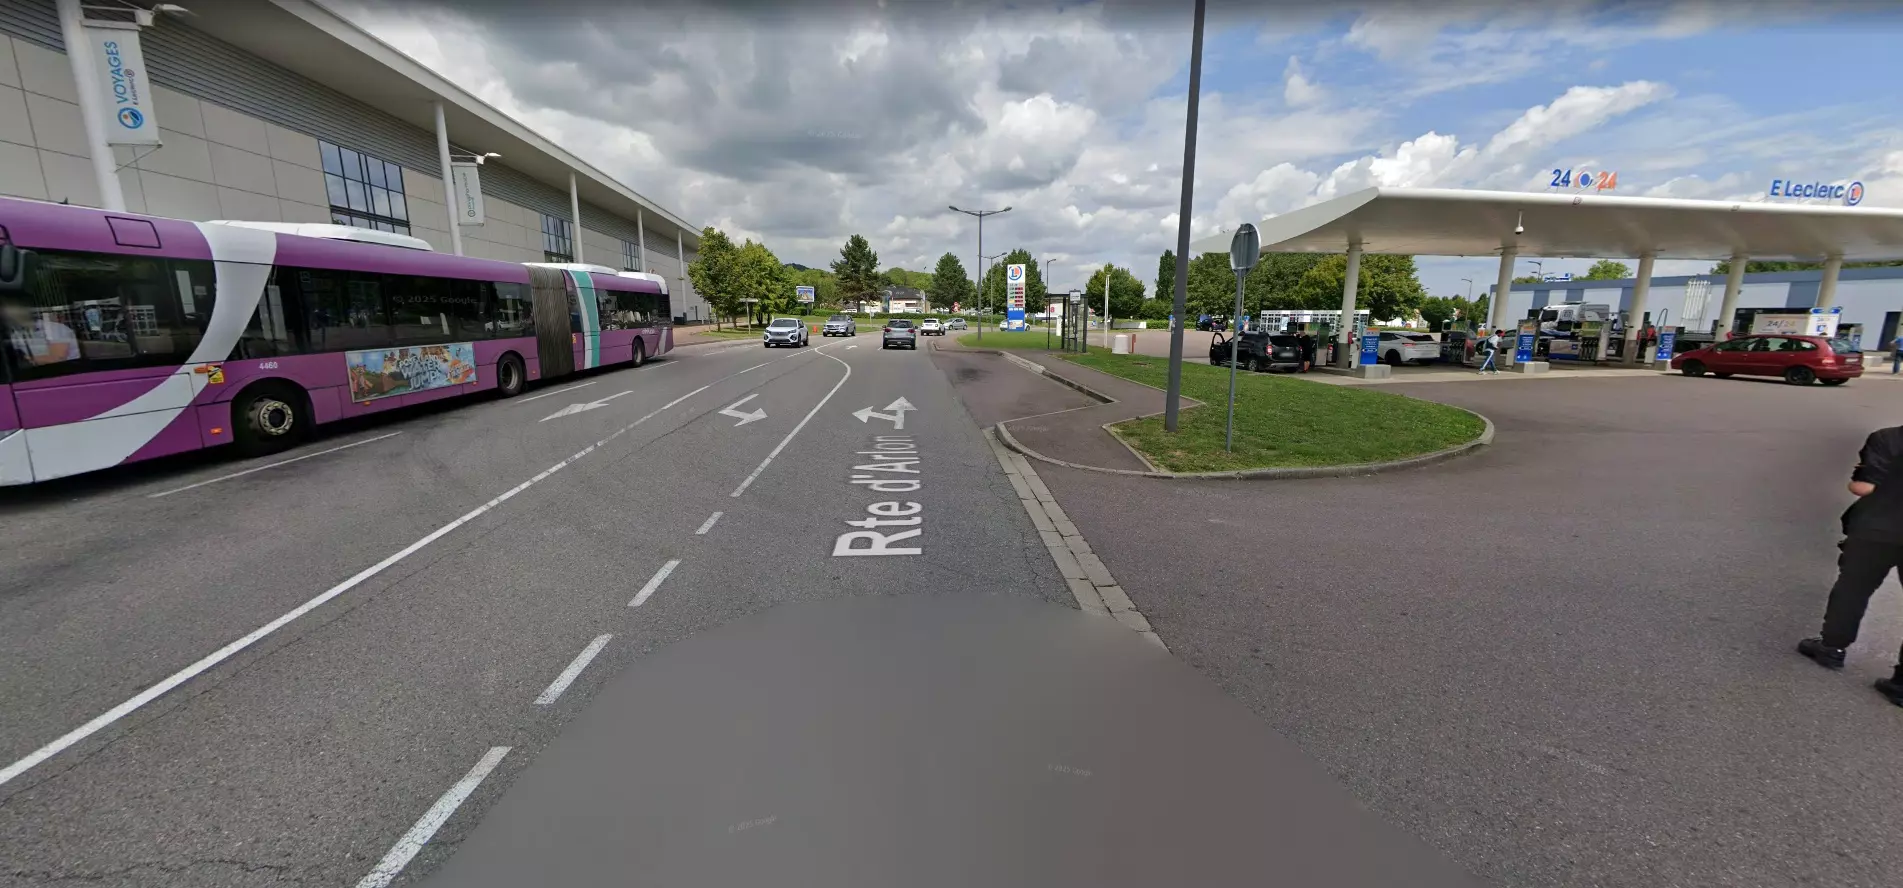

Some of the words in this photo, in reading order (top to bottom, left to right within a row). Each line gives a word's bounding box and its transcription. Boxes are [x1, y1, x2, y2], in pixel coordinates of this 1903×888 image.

[104, 41, 128, 104] VOYAGES
[1551, 169, 1571, 187] 24
[1597, 171, 1617, 190] 24
[401, 356, 441, 379] WATER
[409, 370, 438, 390] JUMP
